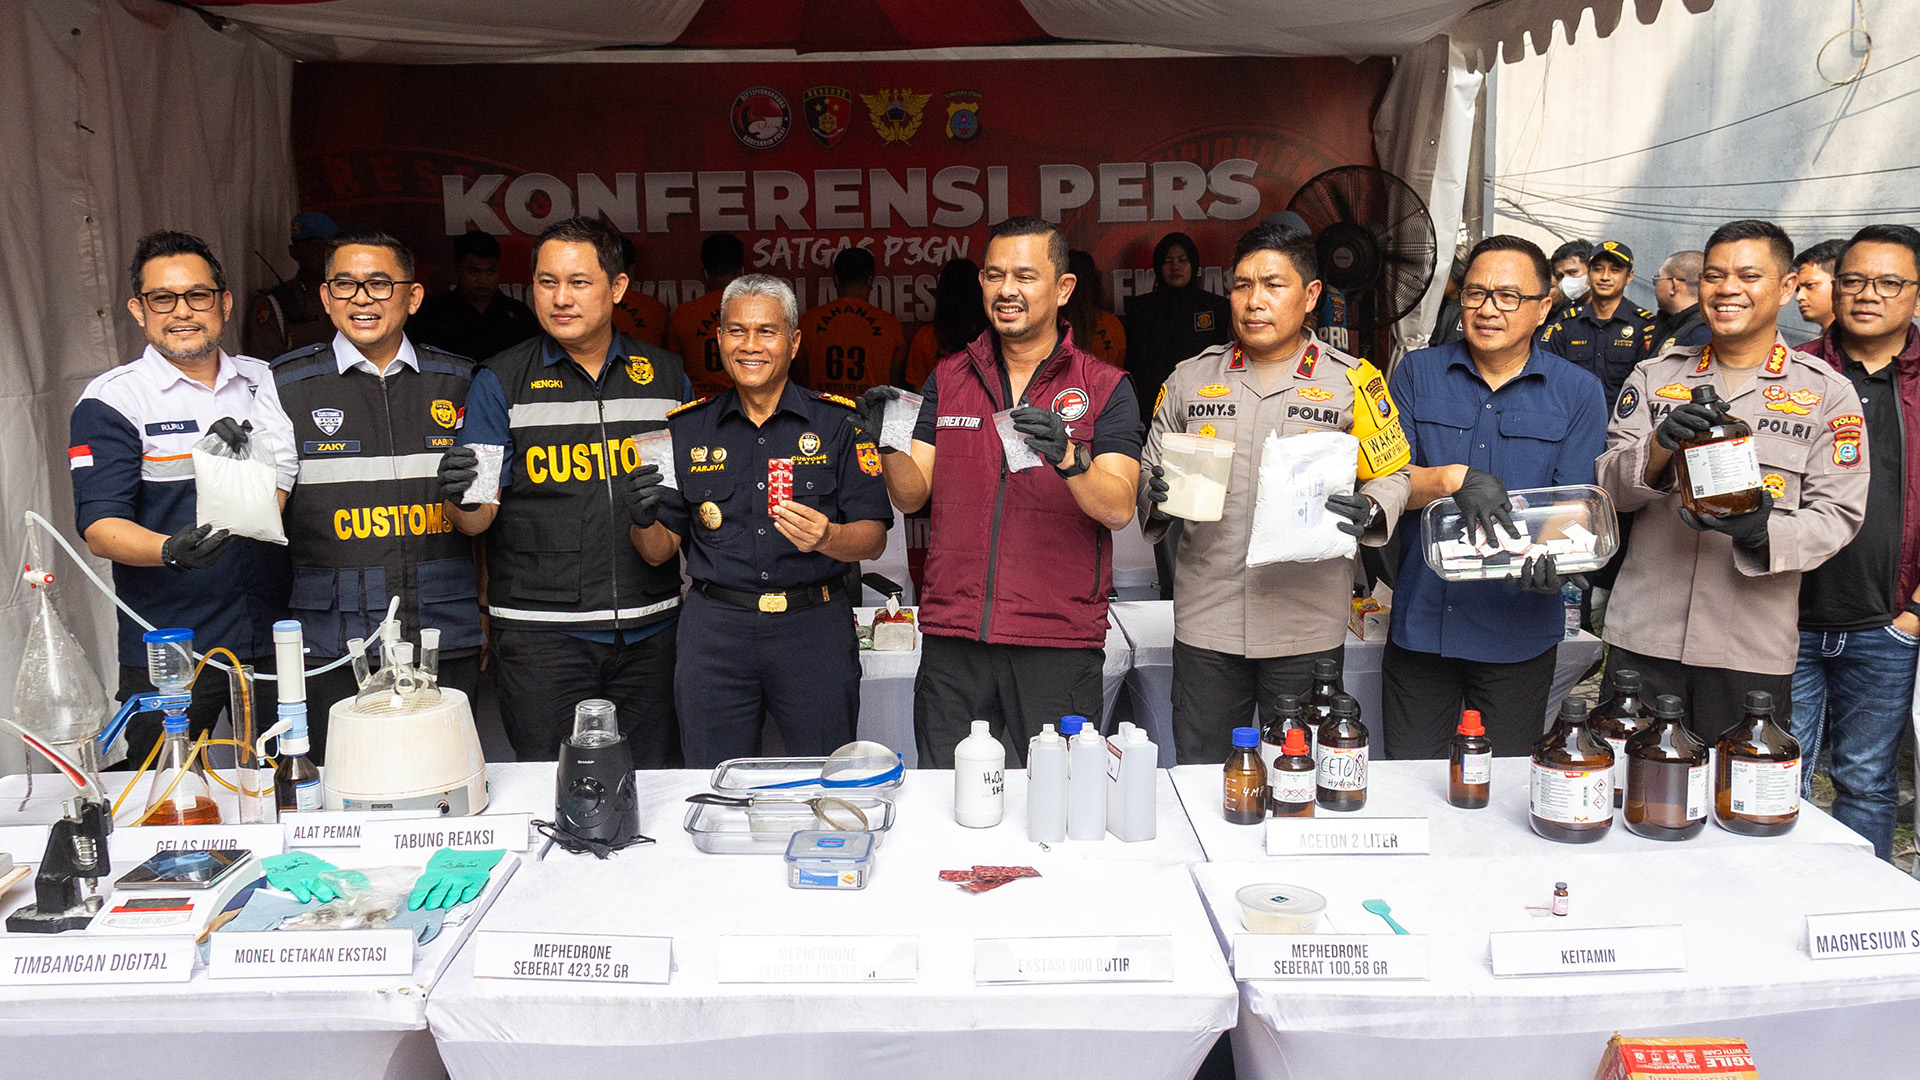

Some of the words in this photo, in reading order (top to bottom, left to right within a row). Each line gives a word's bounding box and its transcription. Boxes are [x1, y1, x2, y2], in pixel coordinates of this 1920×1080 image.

[807, 87, 847, 97] RESERSE
[441, 164, 1007, 237] KONFERENSI
[1039, 158, 1262, 225] PERS
[883, 234, 971, 267] P3GN
[817, 304, 882, 338] TAHANAN
[825, 345, 867, 382] 63
[530, 379, 564, 390] HENGKI
[1188, 403, 1237, 418] RONY.S
[1287, 405, 1340, 425] POLRI
[161, 422, 185, 433] RURU
[936, 415, 981, 428] DIREKTUR
[1757, 418, 1812, 440] POLRI
[1832, 416, 1862, 429] POLDA
[317, 443, 346, 451] ZAKY
[526, 437, 643, 484] CUSTO
[690, 463, 725, 474] PARJIYA
[293, 825, 321, 839] ALAT
[323, 825, 362, 839] PEMAN
[393, 832, 444, 849] TABUNG
[448, 829, 495, 847] REAKSI
[1299, 833, 1347, 848] ACETON
[1352, 833, 1359, 848] 2
[1363, 833, 1399, 849] LITER
[1816, 930, 1907, 953] MAGNESIUM
[234, 948, 278, 964] MONEL
[280, 947, 334, 963] CETAKAN
[338, 946, 387, 962] EKSTASI
[533, 943, 613, 960] MEPHEDRONE
[778, 947, 858, 962] MEPHEDRONE
[1291, 943, 1369, 959] MEPHEDRONE
[1560, 948, 1616, 964] KEITAMIN
[14, 954, 108, 975] TIMBANGAN
[110, 952, 168, 972] DIGITAL
[513, 960, 565, 976] SEBERAT
[568, 961, 610, 978] 423,52
[613, 963, 629, 978] GR
[759, 963, 811, 978] SEBERAT
[1018, 958, 1066, 973] EKSTASI
[1070, 958, 1092, 973] 600
[1096, 957, 1131, 973] BUTIR
[1274, 960, 1326, 975] SEBERAT
[1328, 960, 1369, 977] 100,58
[1371, 960, 1388, 975] GR
